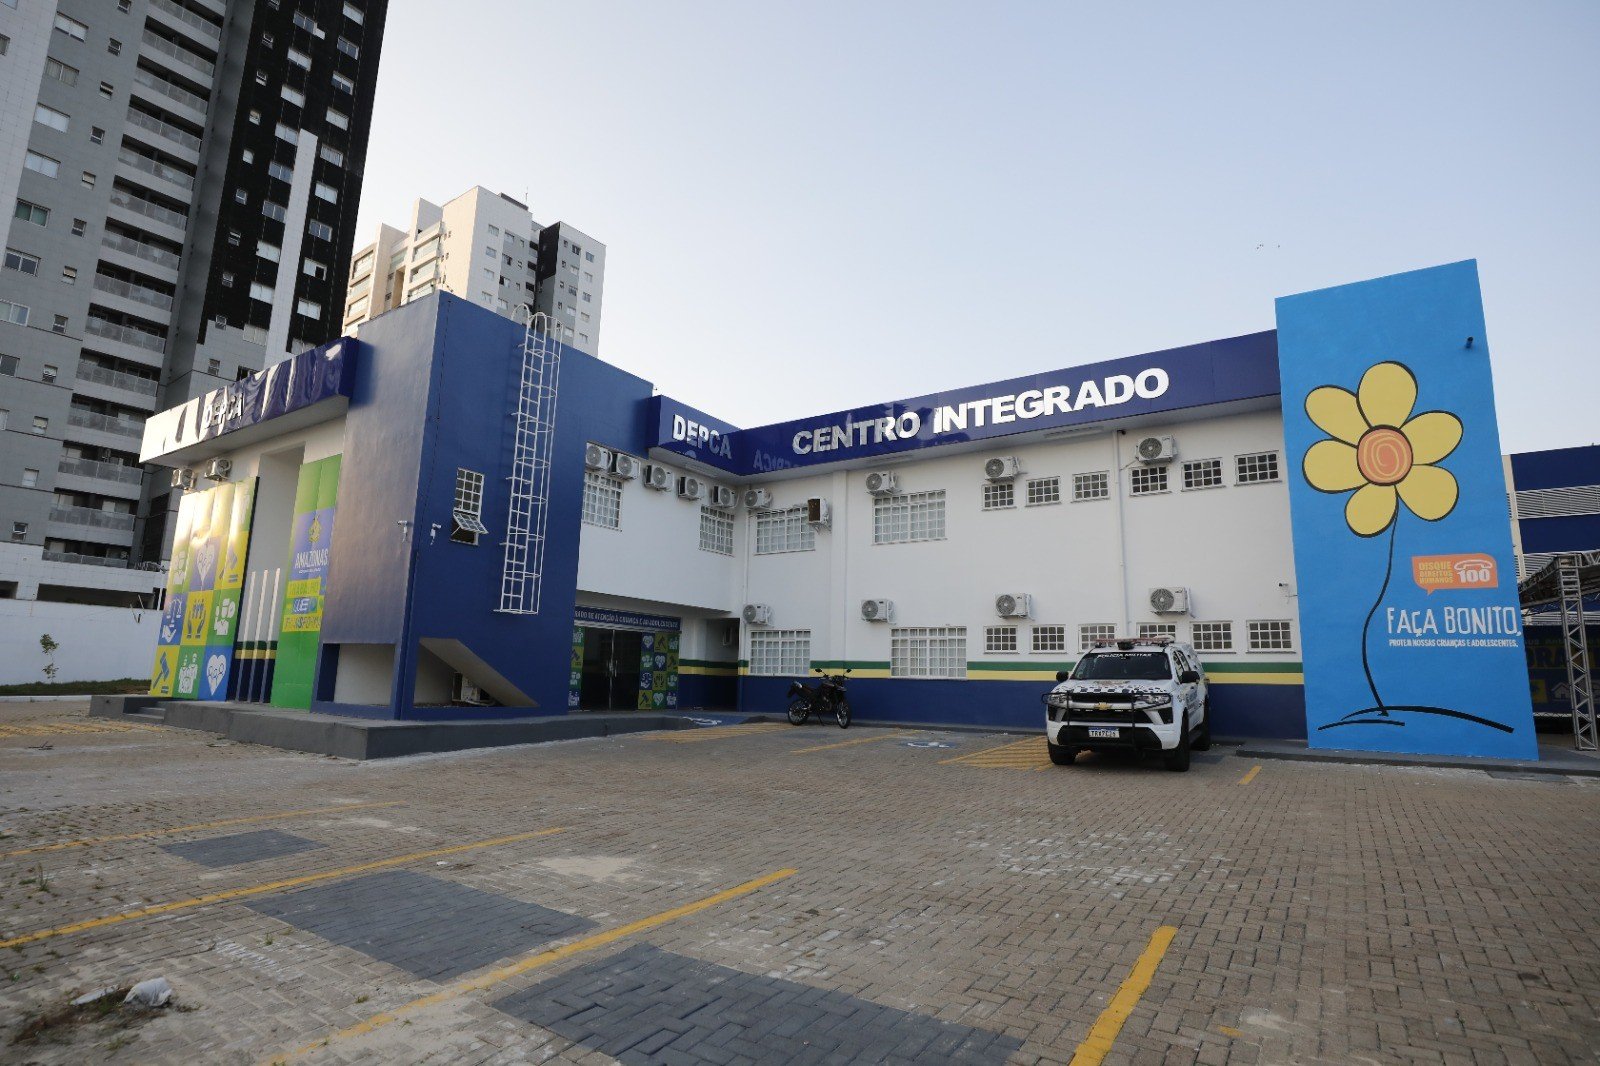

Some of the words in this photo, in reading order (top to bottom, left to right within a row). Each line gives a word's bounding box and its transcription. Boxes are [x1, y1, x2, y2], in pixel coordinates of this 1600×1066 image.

[204, 392, 243, 429] DEPCA
[792, 411, 922, 456] CENTRO
[932, 367, 1170, 435] INTEGRADO
[672, 414, 732, 460] DEPCA
[294, 548, 329, 569] AMAZONAS
[1418, 561, 1452, 571] DISQUE
[1419, 569, 1453, 578] DIREITOS
[1457, 568, 1491, 583] 100
[1419, 576, 1453, 584] HUMANOS
[1386, 607, 1439, 637] FAÇA
[1443, 606, 1522, 637] BONITO,
[1412, 639, 1436, 647] NOSSAS
[1436, 639, 1466, 648] CRIANÇAS
